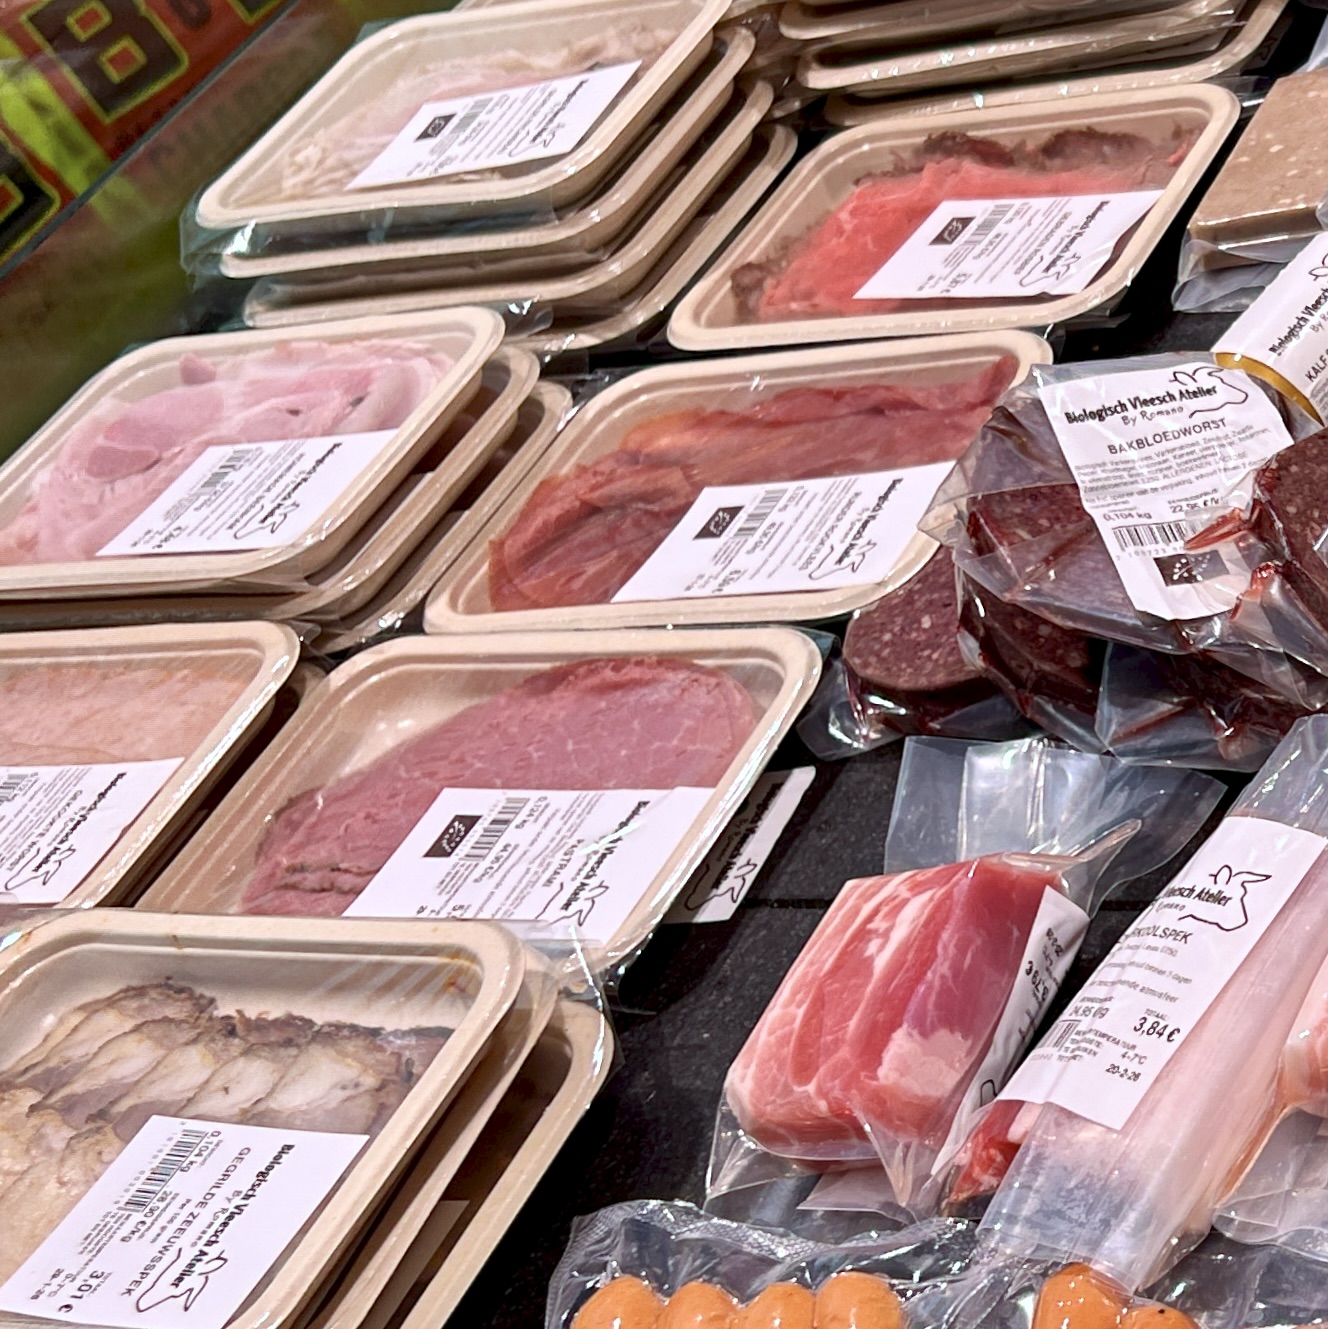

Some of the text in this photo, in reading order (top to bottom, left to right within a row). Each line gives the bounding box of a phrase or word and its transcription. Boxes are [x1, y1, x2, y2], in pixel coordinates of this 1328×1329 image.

[1268, 315, 1309, 356] Biologisch
[1309, 321, 1325, 333] By
[1304, 354, 1327, 382] KALF
[1064, 385, 1218, 424] Biologisch Vleesch Atelier
[1121, 407, 1184, 427] By Romano
[1107, 417, 1228, 455] BAKBLOEDWORST
[541, 838, 585, 887] PASTRAMI
[559, 845, 617, 911] Vleesch Atelier
[1192, 887, 1232, 906] Atelier
[1132, 1016, 1181, 1043] 3,84 €
[178, 1129, 222, 1173] 0,104 kg
[119, 1190, 172, 1243] 28,90 €/kg
[120, 1146, 251, 1296] GEGRILDE ZEEUWSSPEK
[169, 1143, 294, 1288] Biologisch Vleesch Atelier
[189, 1189, 243, 1248] By Romano
[57, 1269, 105, 1313] 3,01 €
